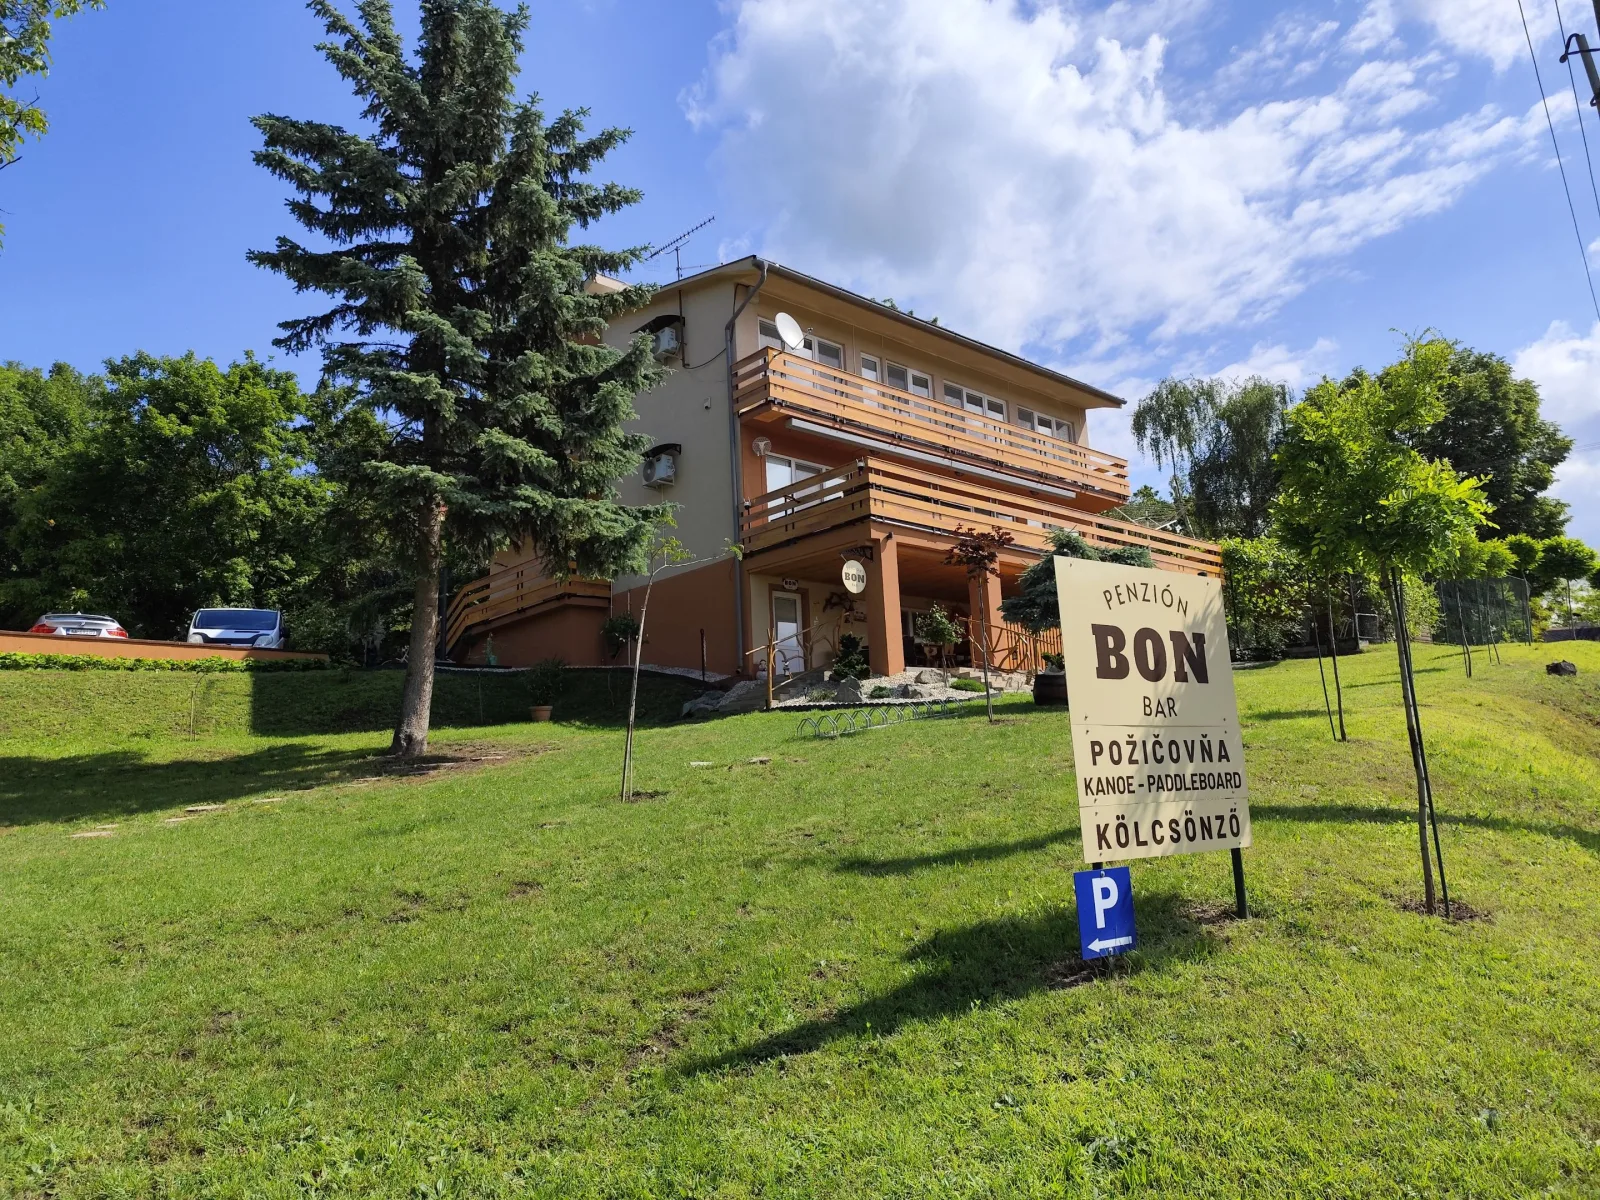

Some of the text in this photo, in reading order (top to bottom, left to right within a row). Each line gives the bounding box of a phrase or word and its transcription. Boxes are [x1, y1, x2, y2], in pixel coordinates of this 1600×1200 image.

[844, 572, 865, 583] BON
[1102, 582, 1189, 618] PENZIÓN
[1091, 623, 1209, 684] BON
[1142, 695, 1178, 718] BAR
[1090, 733, 1231, 766] POŽIČOVŇA
[1096, 807, 1241, 851] KÖLCSÖNZŐ
[1091, 876, 1119, 929] P
